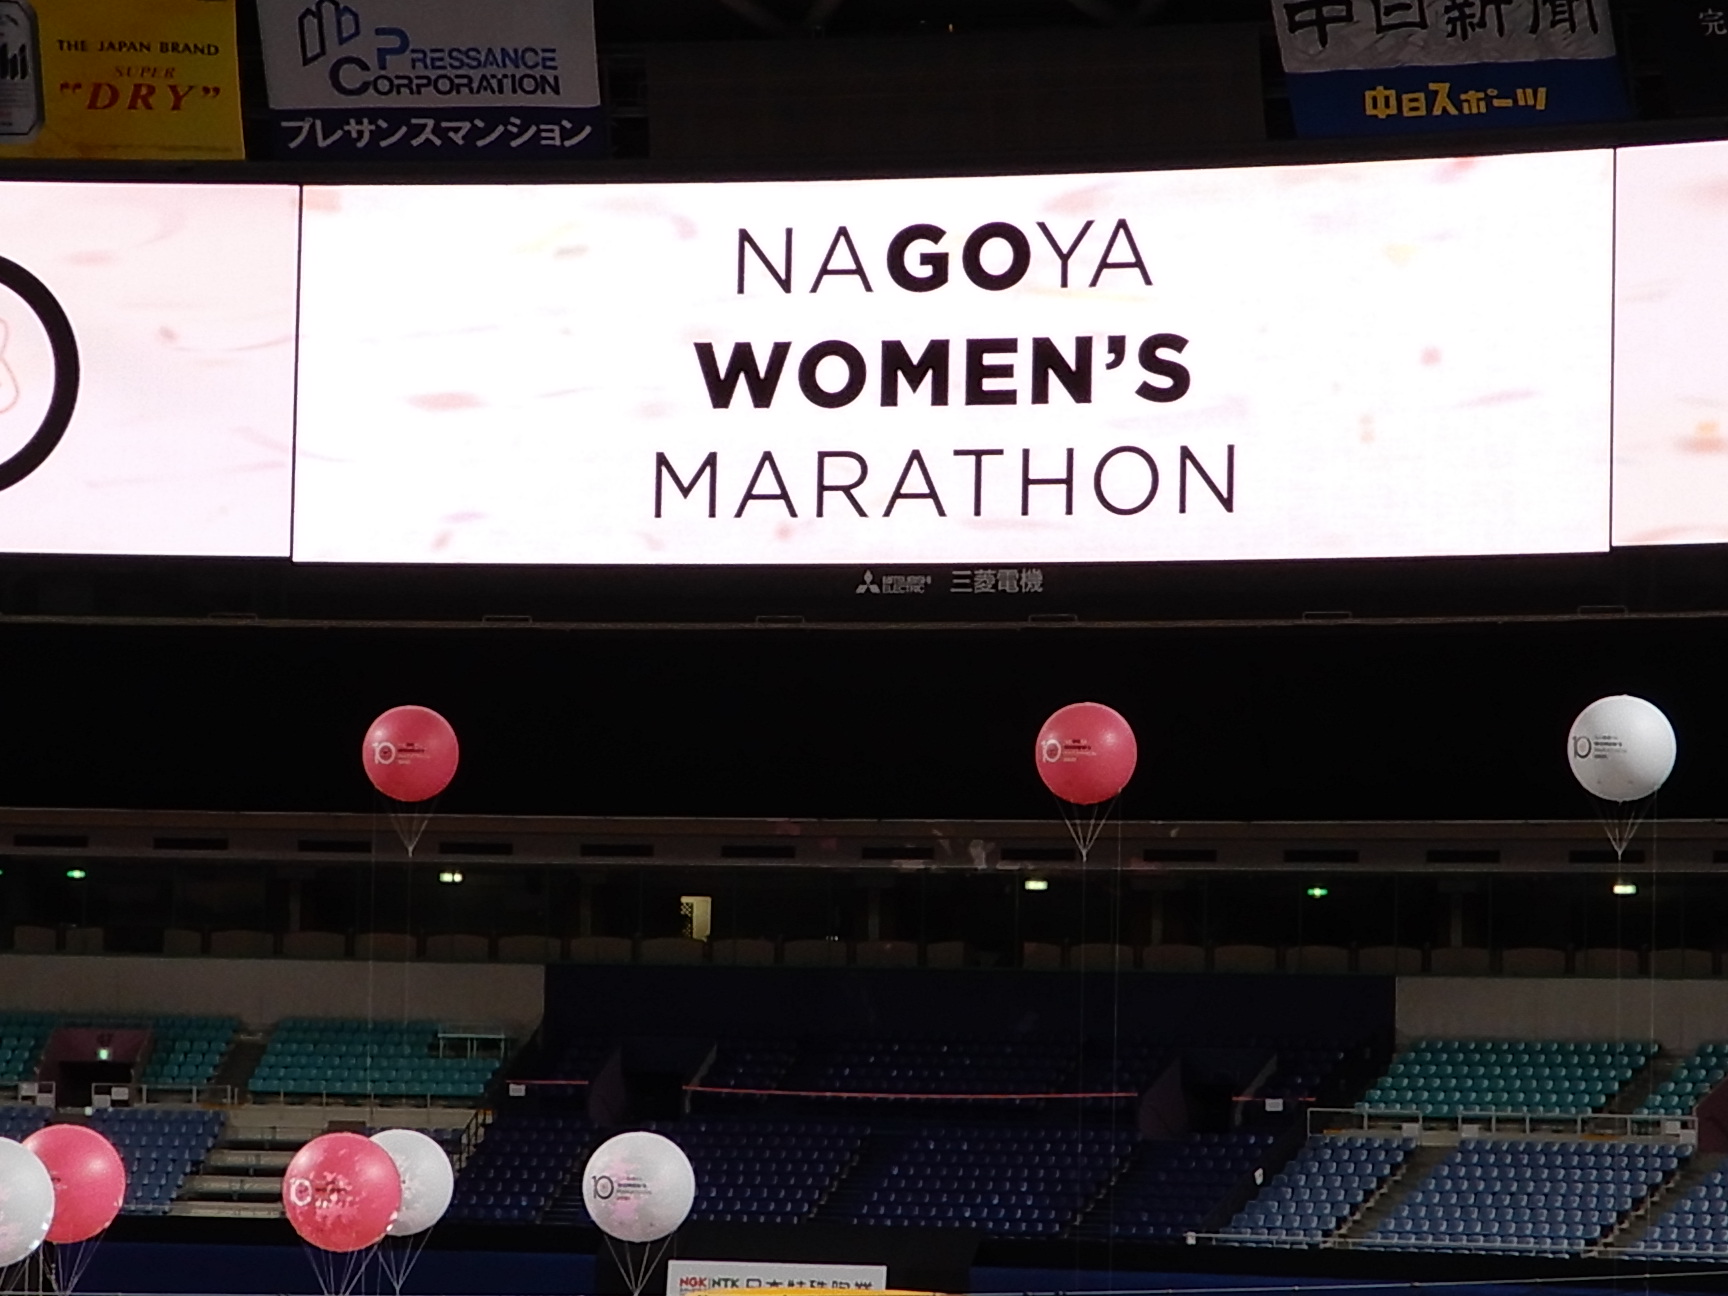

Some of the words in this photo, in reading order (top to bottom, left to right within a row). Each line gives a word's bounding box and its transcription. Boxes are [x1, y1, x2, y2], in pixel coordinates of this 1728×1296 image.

[57, 39, 88, 52] THE
[97, 40, 151, 54] JAPAN
[159, 41, 220, 56] BRAND
[114, 66, 176, 79] SUPER
[1364, 80, 1549, 122] 中日スポーツ
[280, 116, 592, 149] プレサンスマンション
[734, 217, 1154, 296] NAGOYA
[653, 443, 1238, 520] MARATHON
[950, 568, 1044, 594] 三菱電機
[680, 1276, 707, 1289] NGK
[713, 1278, 740, 1290] NTK
